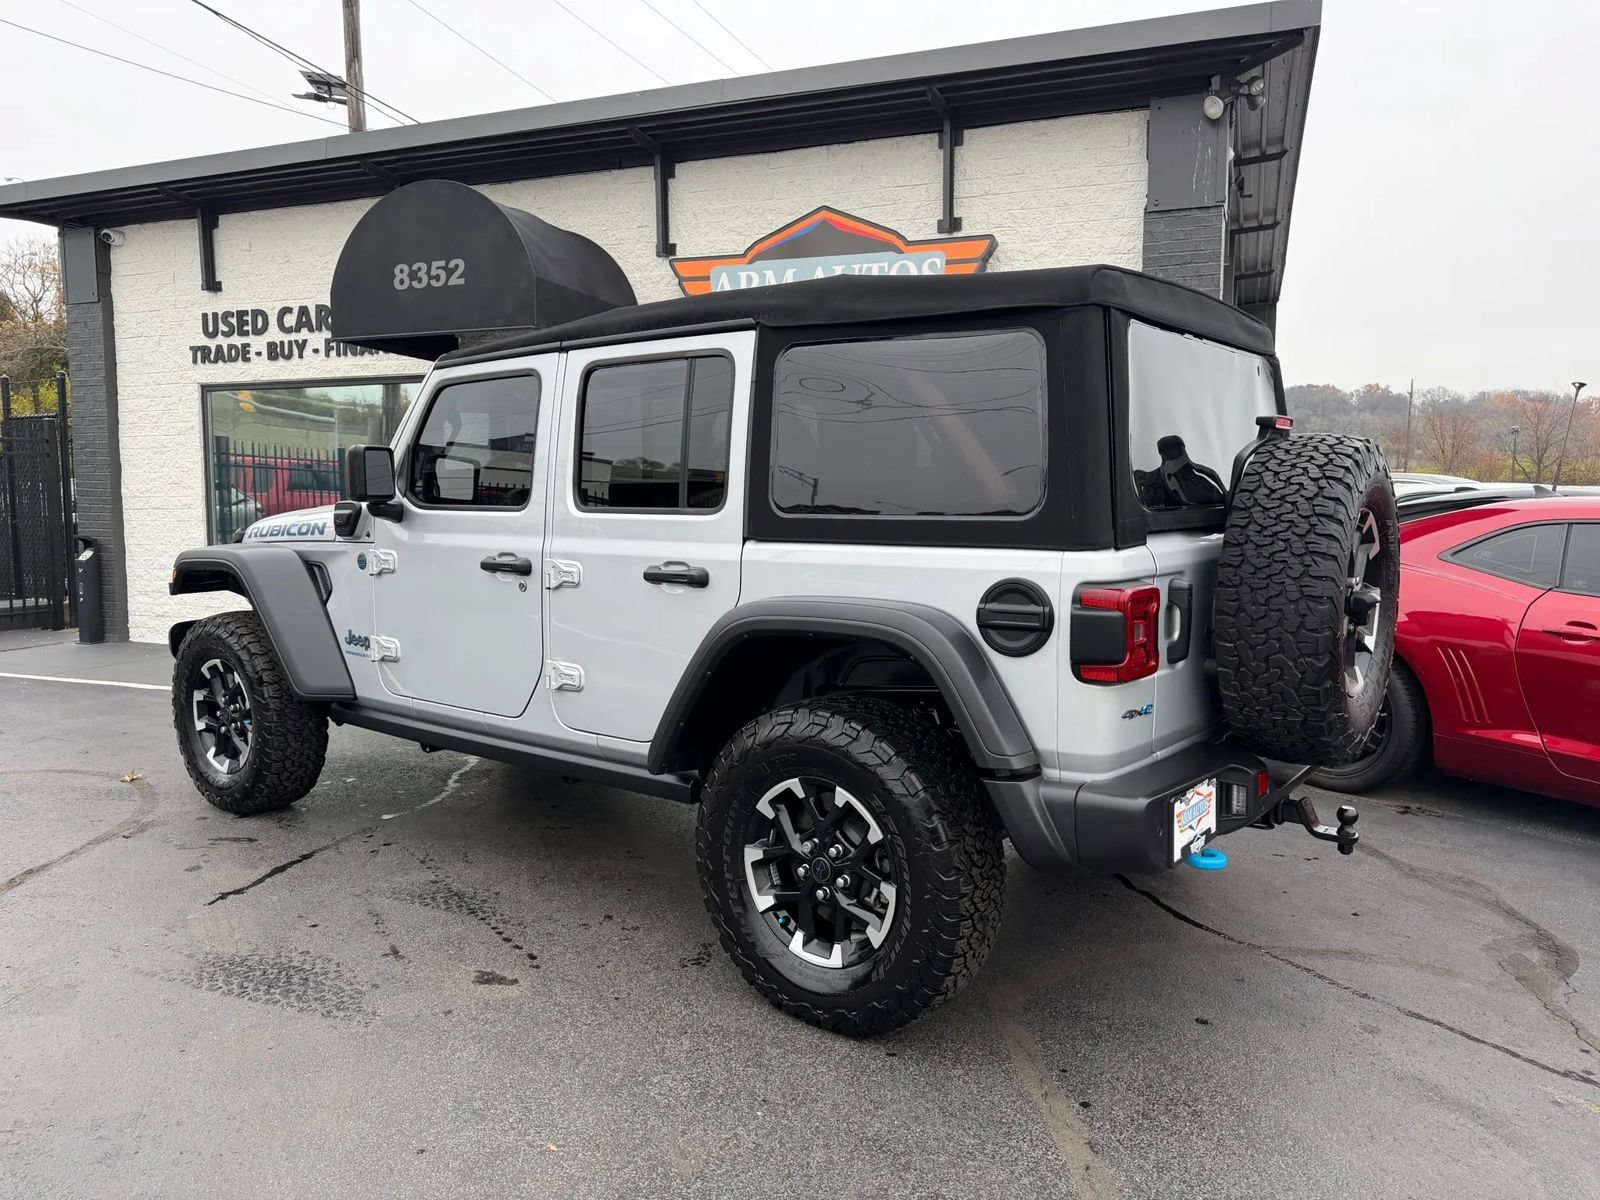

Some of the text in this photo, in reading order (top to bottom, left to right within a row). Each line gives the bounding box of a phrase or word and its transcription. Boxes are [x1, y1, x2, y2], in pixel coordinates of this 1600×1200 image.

[393, 258, 465, 290] 8352
[201, 309, 269, 339] USED
[189, 343, 251, 364] TRADE
[266, 339, 308, 361] BUY
[325, 338, 391, 357] FINA
[248, 522, 328, 539] RUBICON
[345, 629, 370, 651] Jeep
